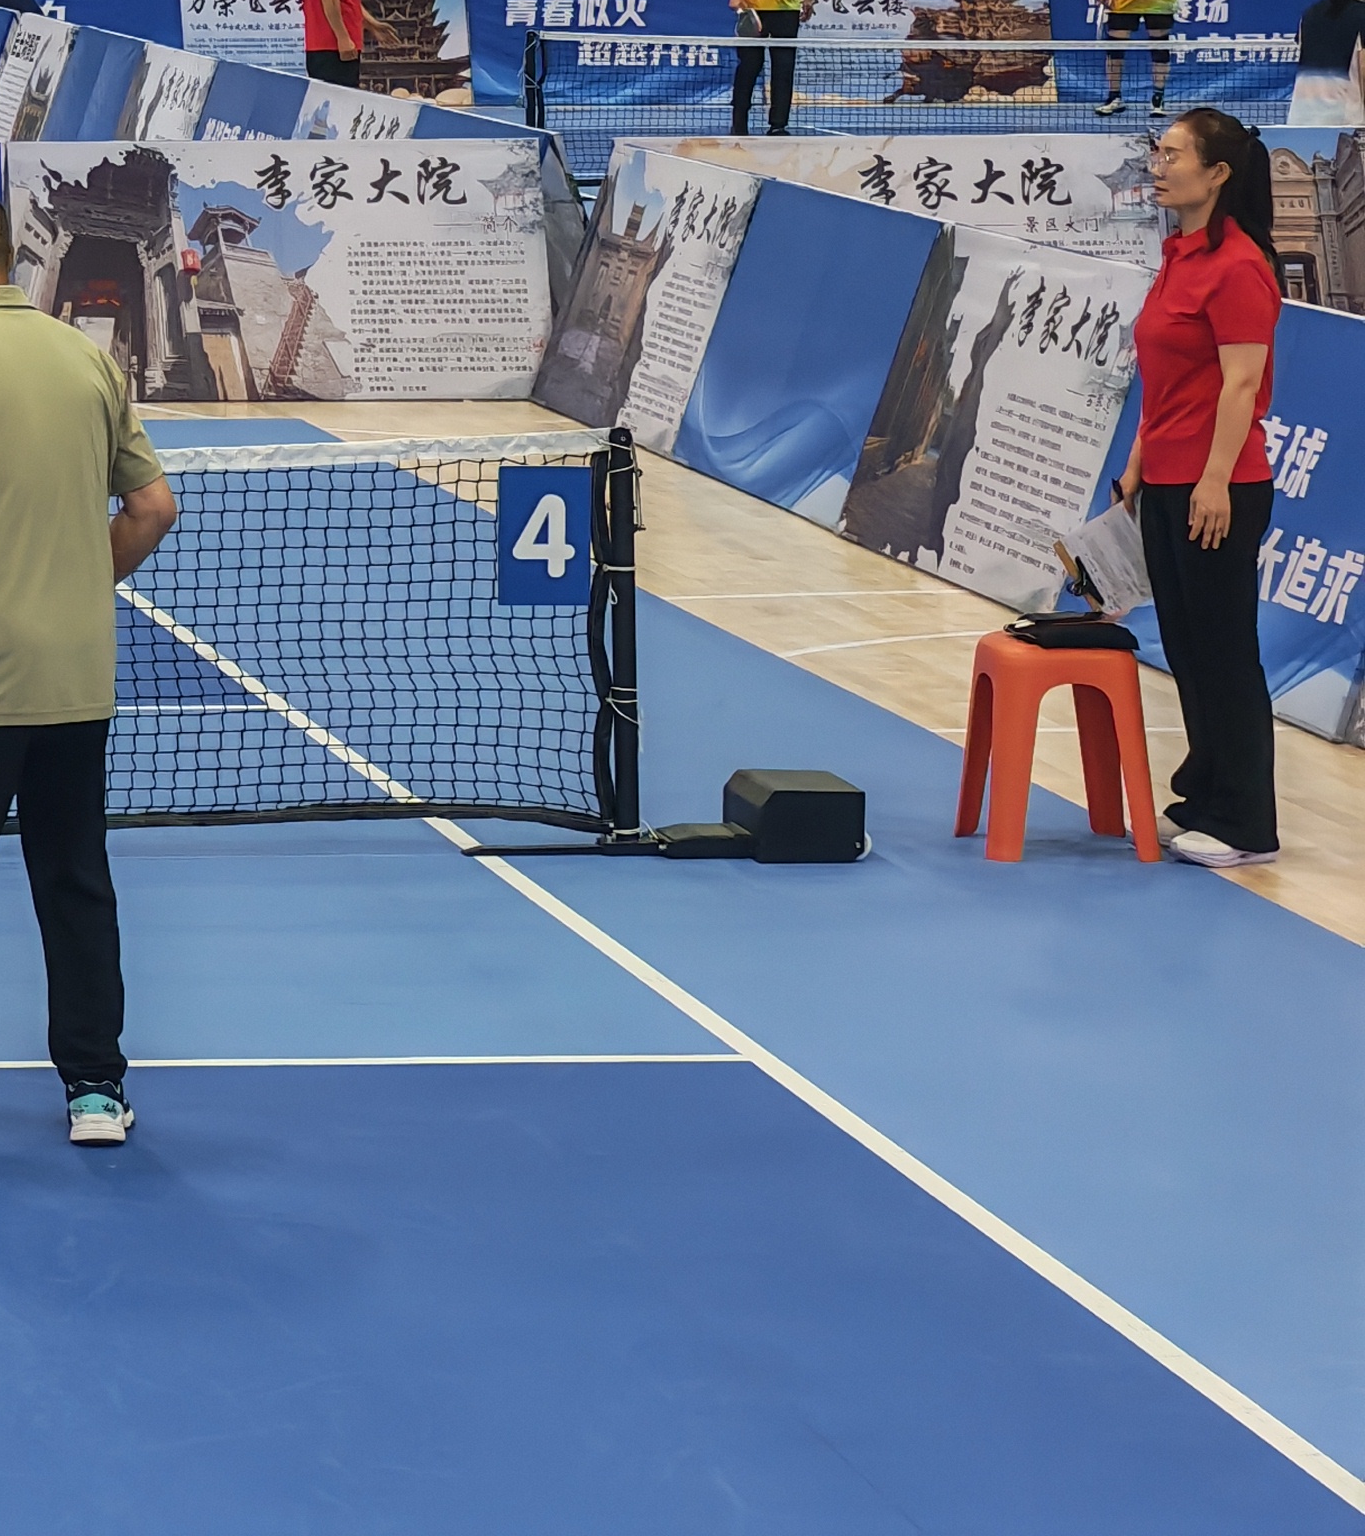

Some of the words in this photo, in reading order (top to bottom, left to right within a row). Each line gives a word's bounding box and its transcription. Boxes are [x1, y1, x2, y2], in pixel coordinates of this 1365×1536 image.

[254, 153, 468, 210] 李家大院
[857, 154, 1073, 210] 李家大院
[481, 215, 518, 233] 简介
[1023, 215, 1099, 233] 景区大门
[1017, 275, 1120, 367] 李家大院
[512, 493, 576, 579] 4
